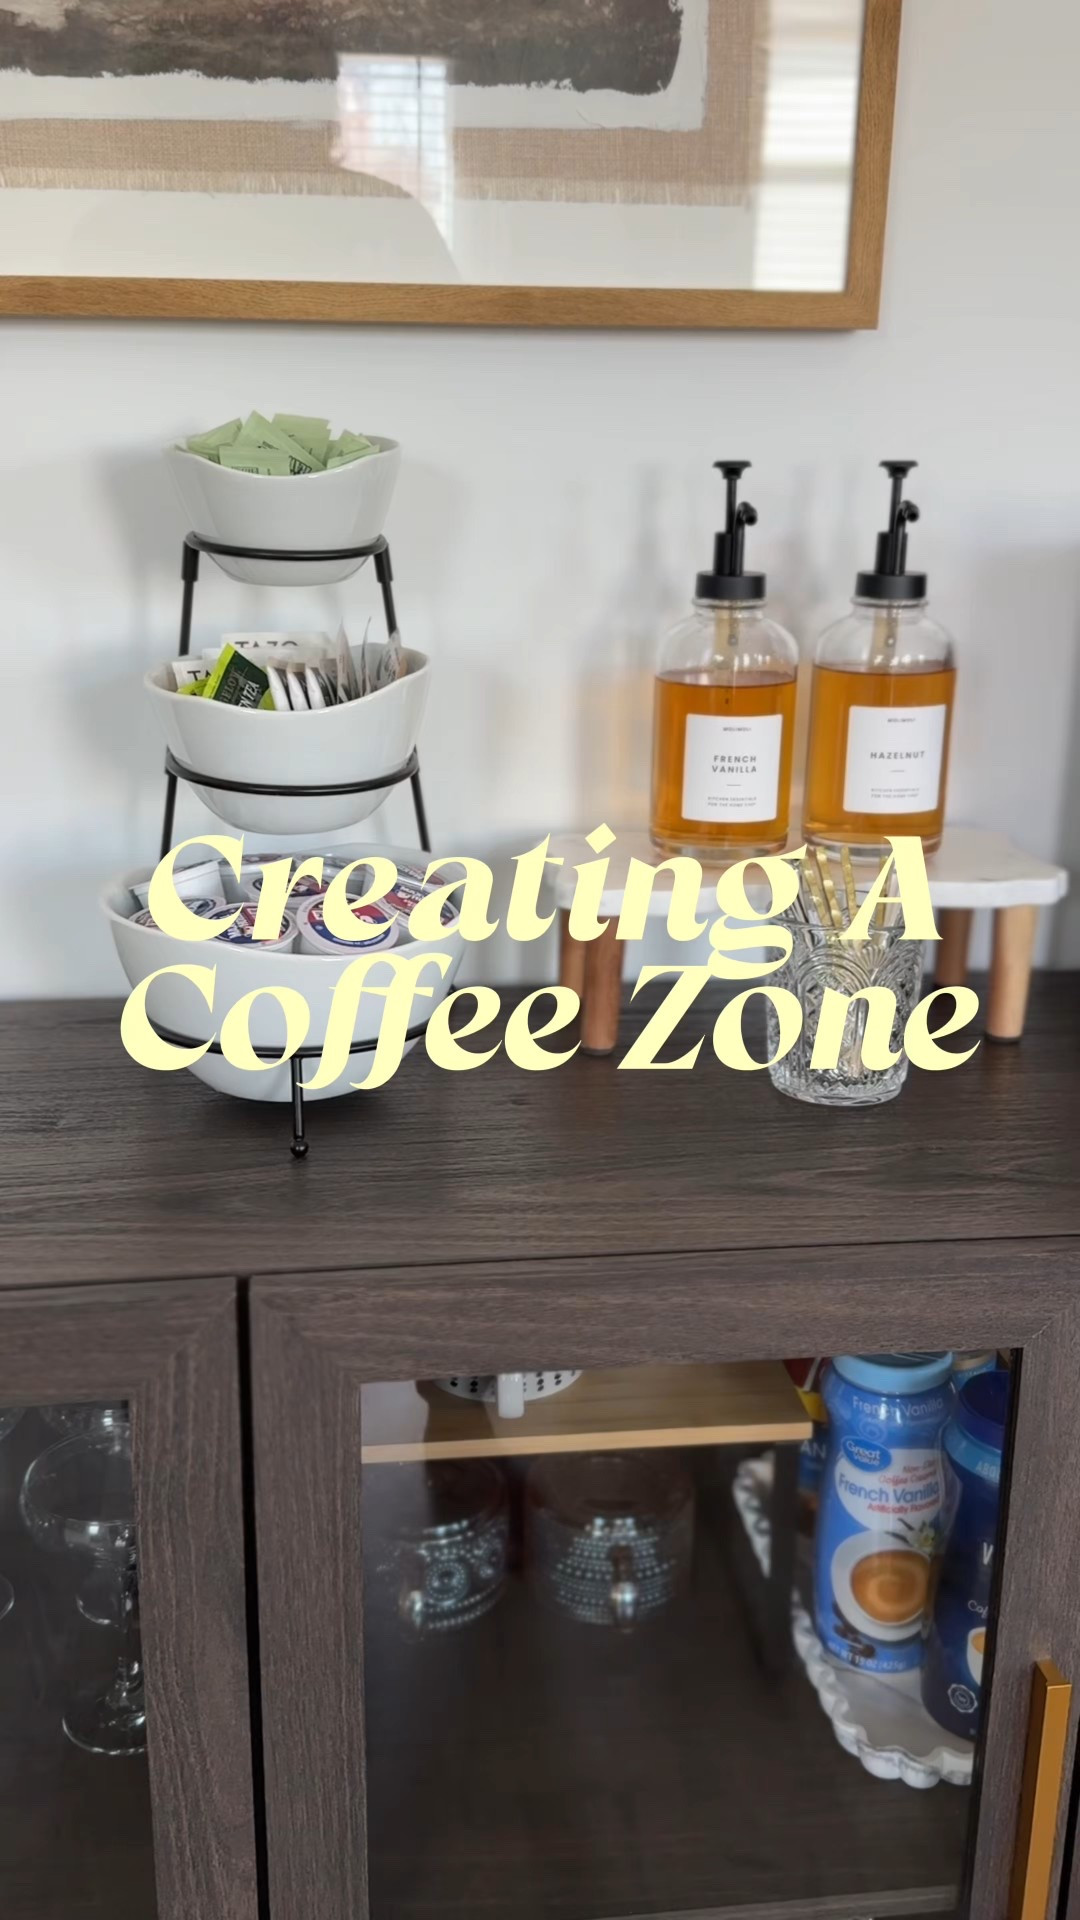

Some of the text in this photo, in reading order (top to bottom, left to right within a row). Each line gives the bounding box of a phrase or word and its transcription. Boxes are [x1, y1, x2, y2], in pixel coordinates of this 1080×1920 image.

[241, 680, 260, 701] TEA
[713, 754, 757, 764] FRENCH
[870, 750, 925, 760] HAZELNUT
[712, 764, 757, 774] VANILLA
[852, 1396, 944, 1417] French Vanilla
[846, 1440, 881, 1459] Great
[838, 1472, 940, 1503] French Vanilla
